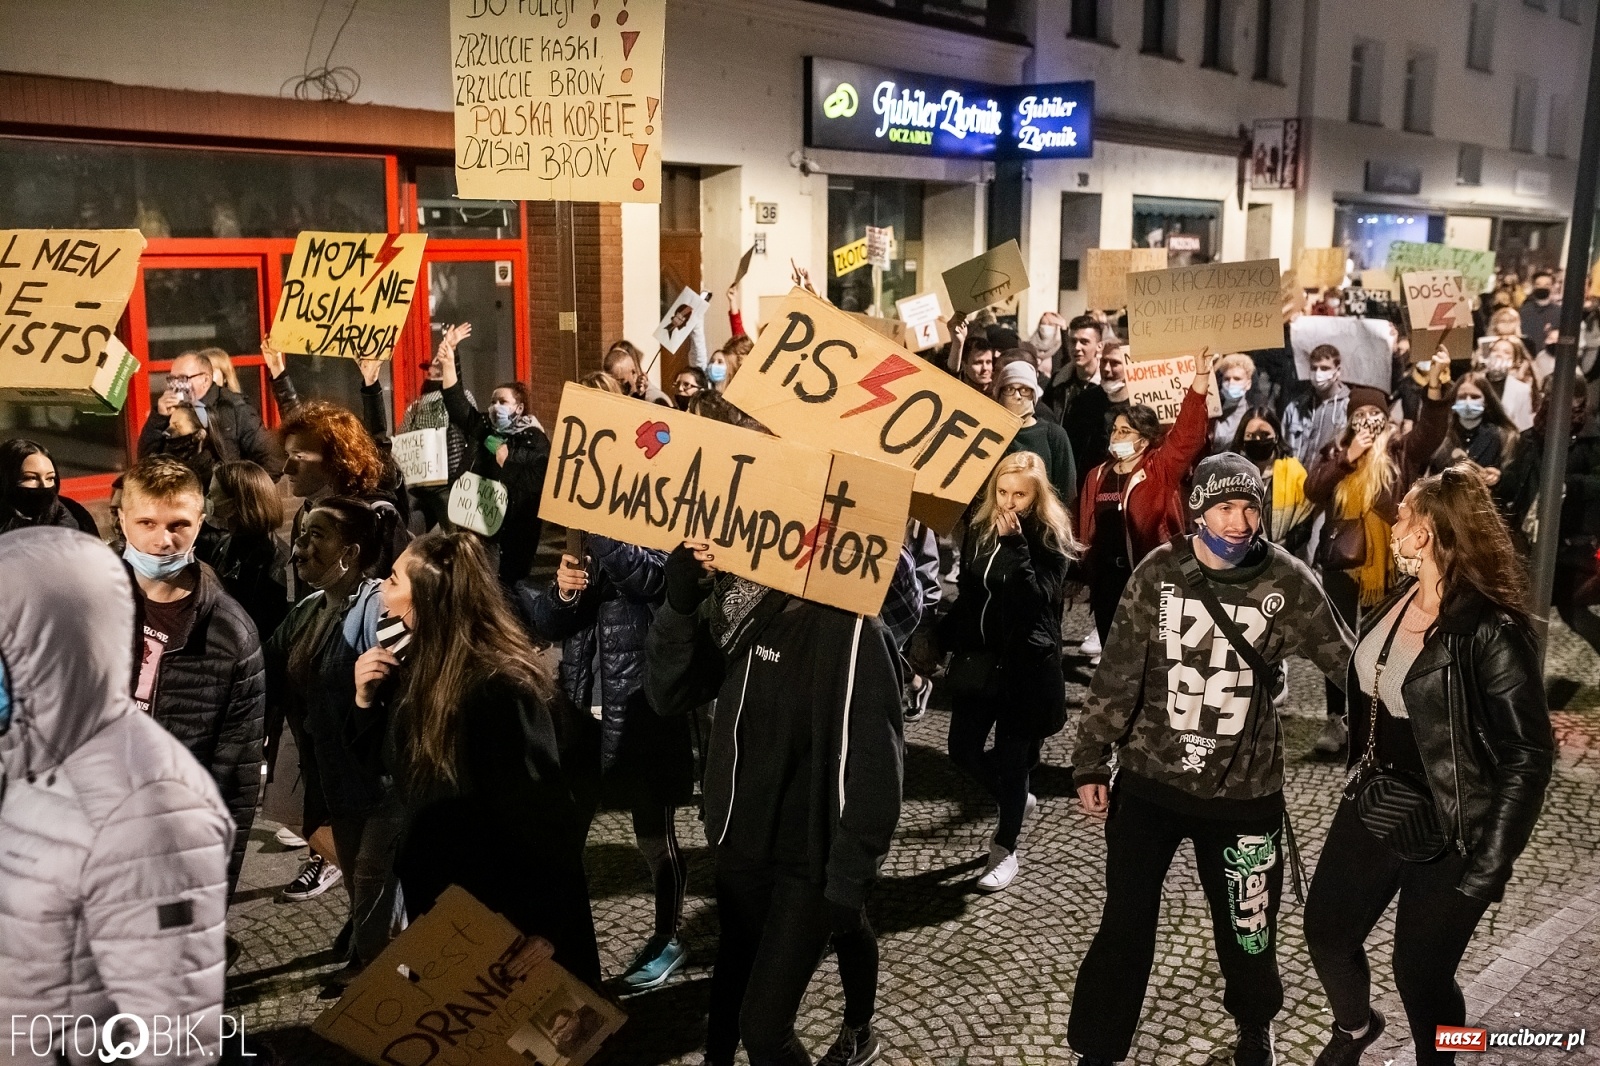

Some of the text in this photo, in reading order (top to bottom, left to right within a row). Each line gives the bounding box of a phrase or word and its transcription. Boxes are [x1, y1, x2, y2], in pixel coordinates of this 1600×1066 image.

[549, 64, 604, 97] BROŃ
[563, 101, 636, 142] KOBIETĘ
[538, 137, 616, 181] BROŃ
[763, 206, 776, 219] 36
[32, 238, 120, 279] MEN
[301, 237, 374, 280] MOJA
[1134, 266, 1275, 296] NO KACZUSZKO
[280, 270, 414, 323] PUSIA NIE
[1133, 299, 1190, 318] KONIEC
[1232, 311, 1273, 330] BABY
[315, 323, 397, 361] JARUSIA
[1177, 359, 1196, 375] RIG
[1133, 390, 1173, 405] SMALL
[1169, 377, 1182, 390] IS
[879, 389, 1005, 490] OFF
[455, 477, 472, 492] NO
[457, 496, 500, 527] NO KRAJ
[755, 644, 781, 663] night
[1178, 733, 1217, 749] PROGRESS
